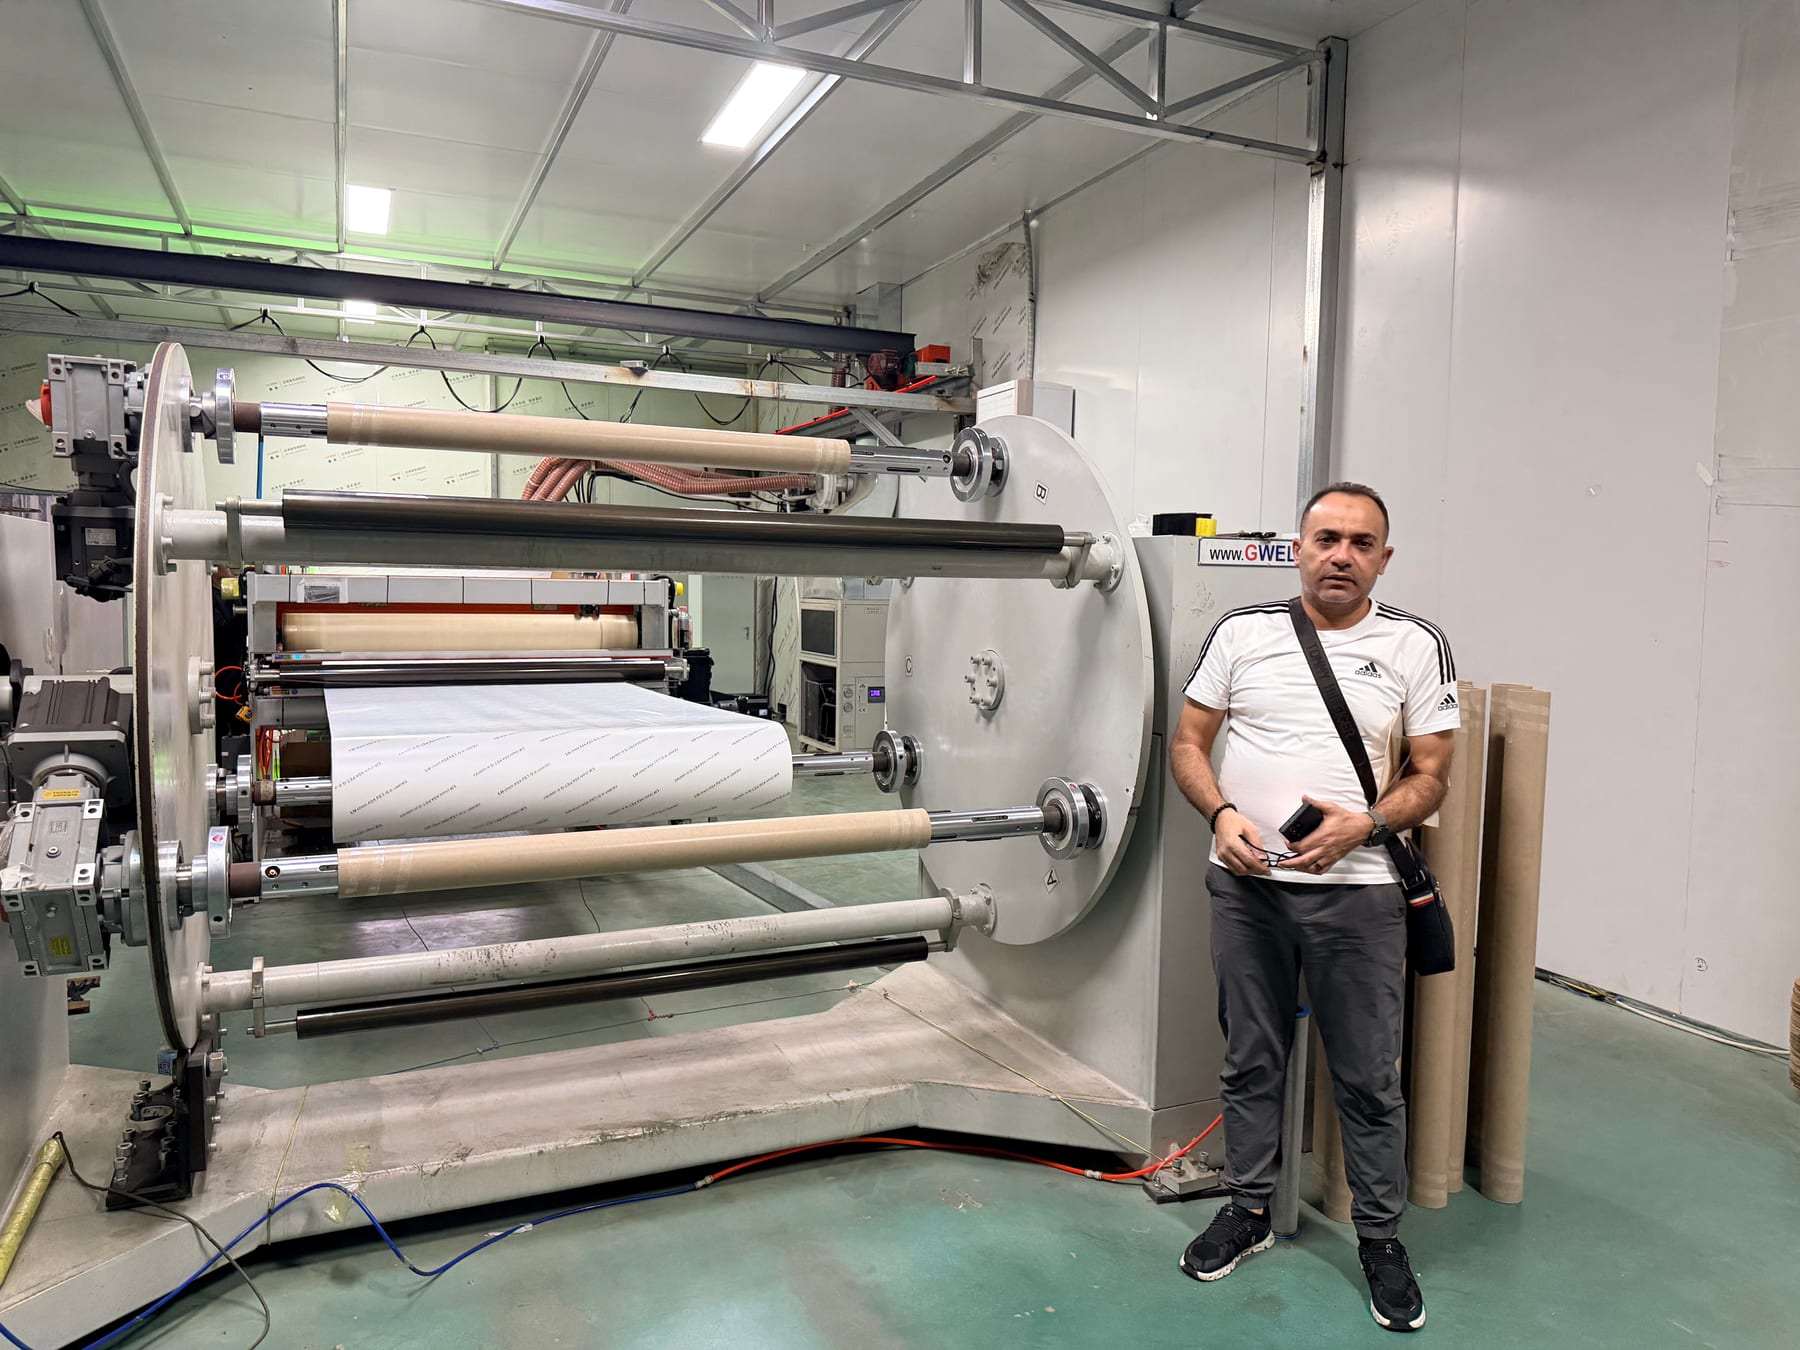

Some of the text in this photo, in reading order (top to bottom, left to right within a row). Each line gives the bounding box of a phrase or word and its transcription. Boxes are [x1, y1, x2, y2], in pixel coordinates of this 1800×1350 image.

[1036, 484, 1047, 499] B
[1209, 543, 1295, 562] www.GWEL
[1355, 670, 1382, 679] adidas
[1437, 703, 1458, 711] adida
[1047, 869, 1057, 885] A
